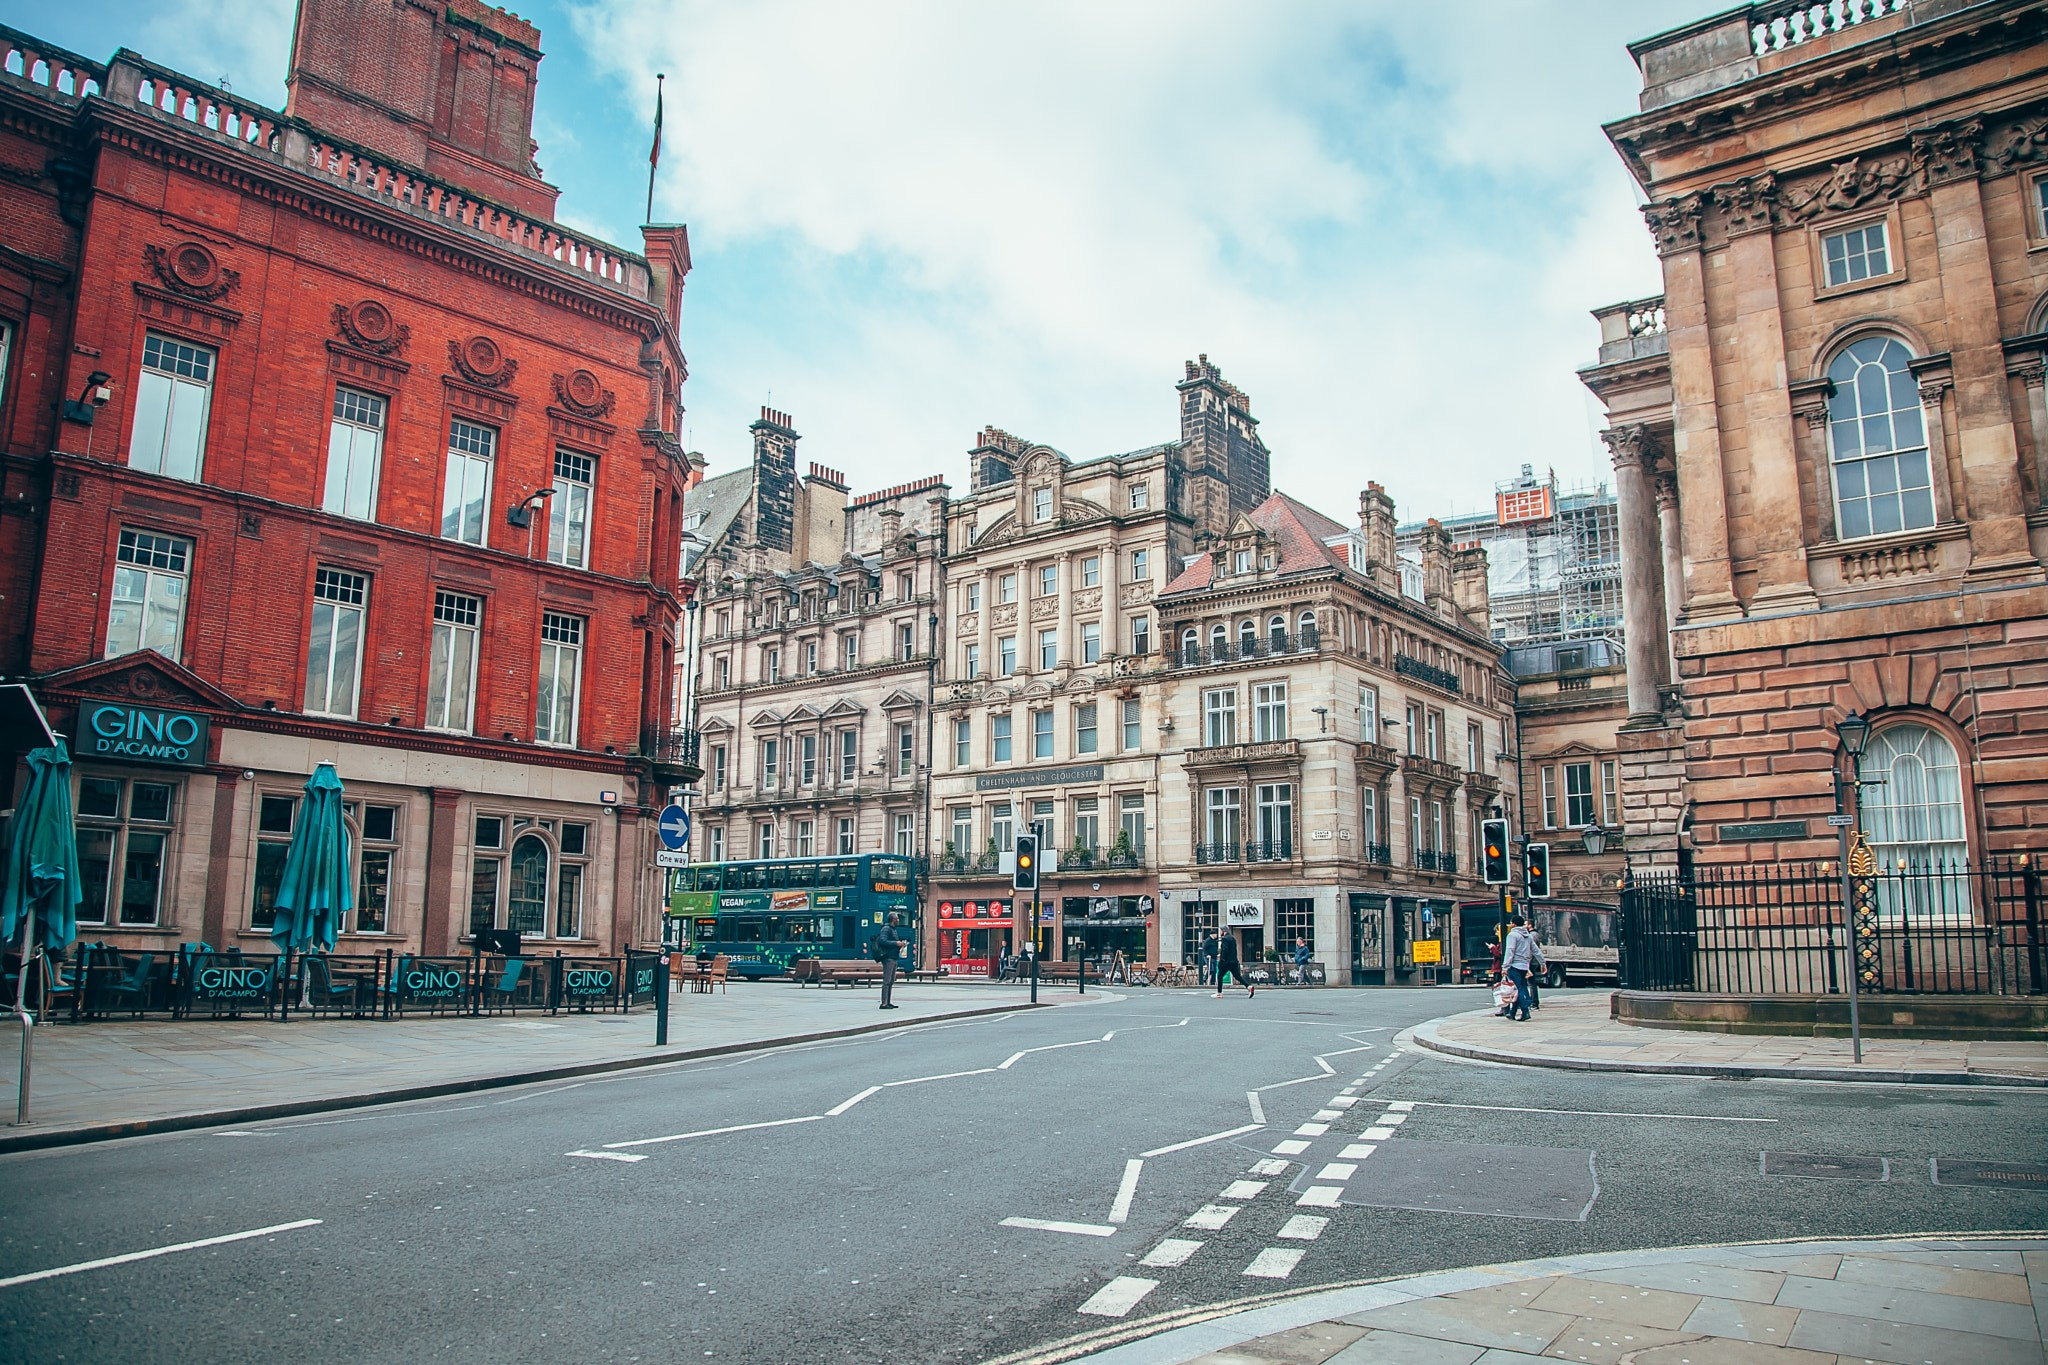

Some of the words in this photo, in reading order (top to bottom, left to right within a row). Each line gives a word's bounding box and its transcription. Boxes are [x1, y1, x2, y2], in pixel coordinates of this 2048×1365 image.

[91, 706, 198, 745] GINO
[96, 738, 188, 760] D'ACAMPO
[980, 777, 1026, 787] CHELTENHAM
[1028, 774, 1046, 782] AND
[1051, 769, 1098, 781] GLOUCESTER
[659, 854, 672, 863] One
[674, 857, 687, 866] way
[720, 898, 744, 907] VEGAN
[201, 969, 266, 989] GINO
[407, 971, 460, 989] GINO
[567, 971, 613, 987] GINO
[636, 969, 653, 986] GINO
[572, 987, 606, 995] D'ACAMPO
